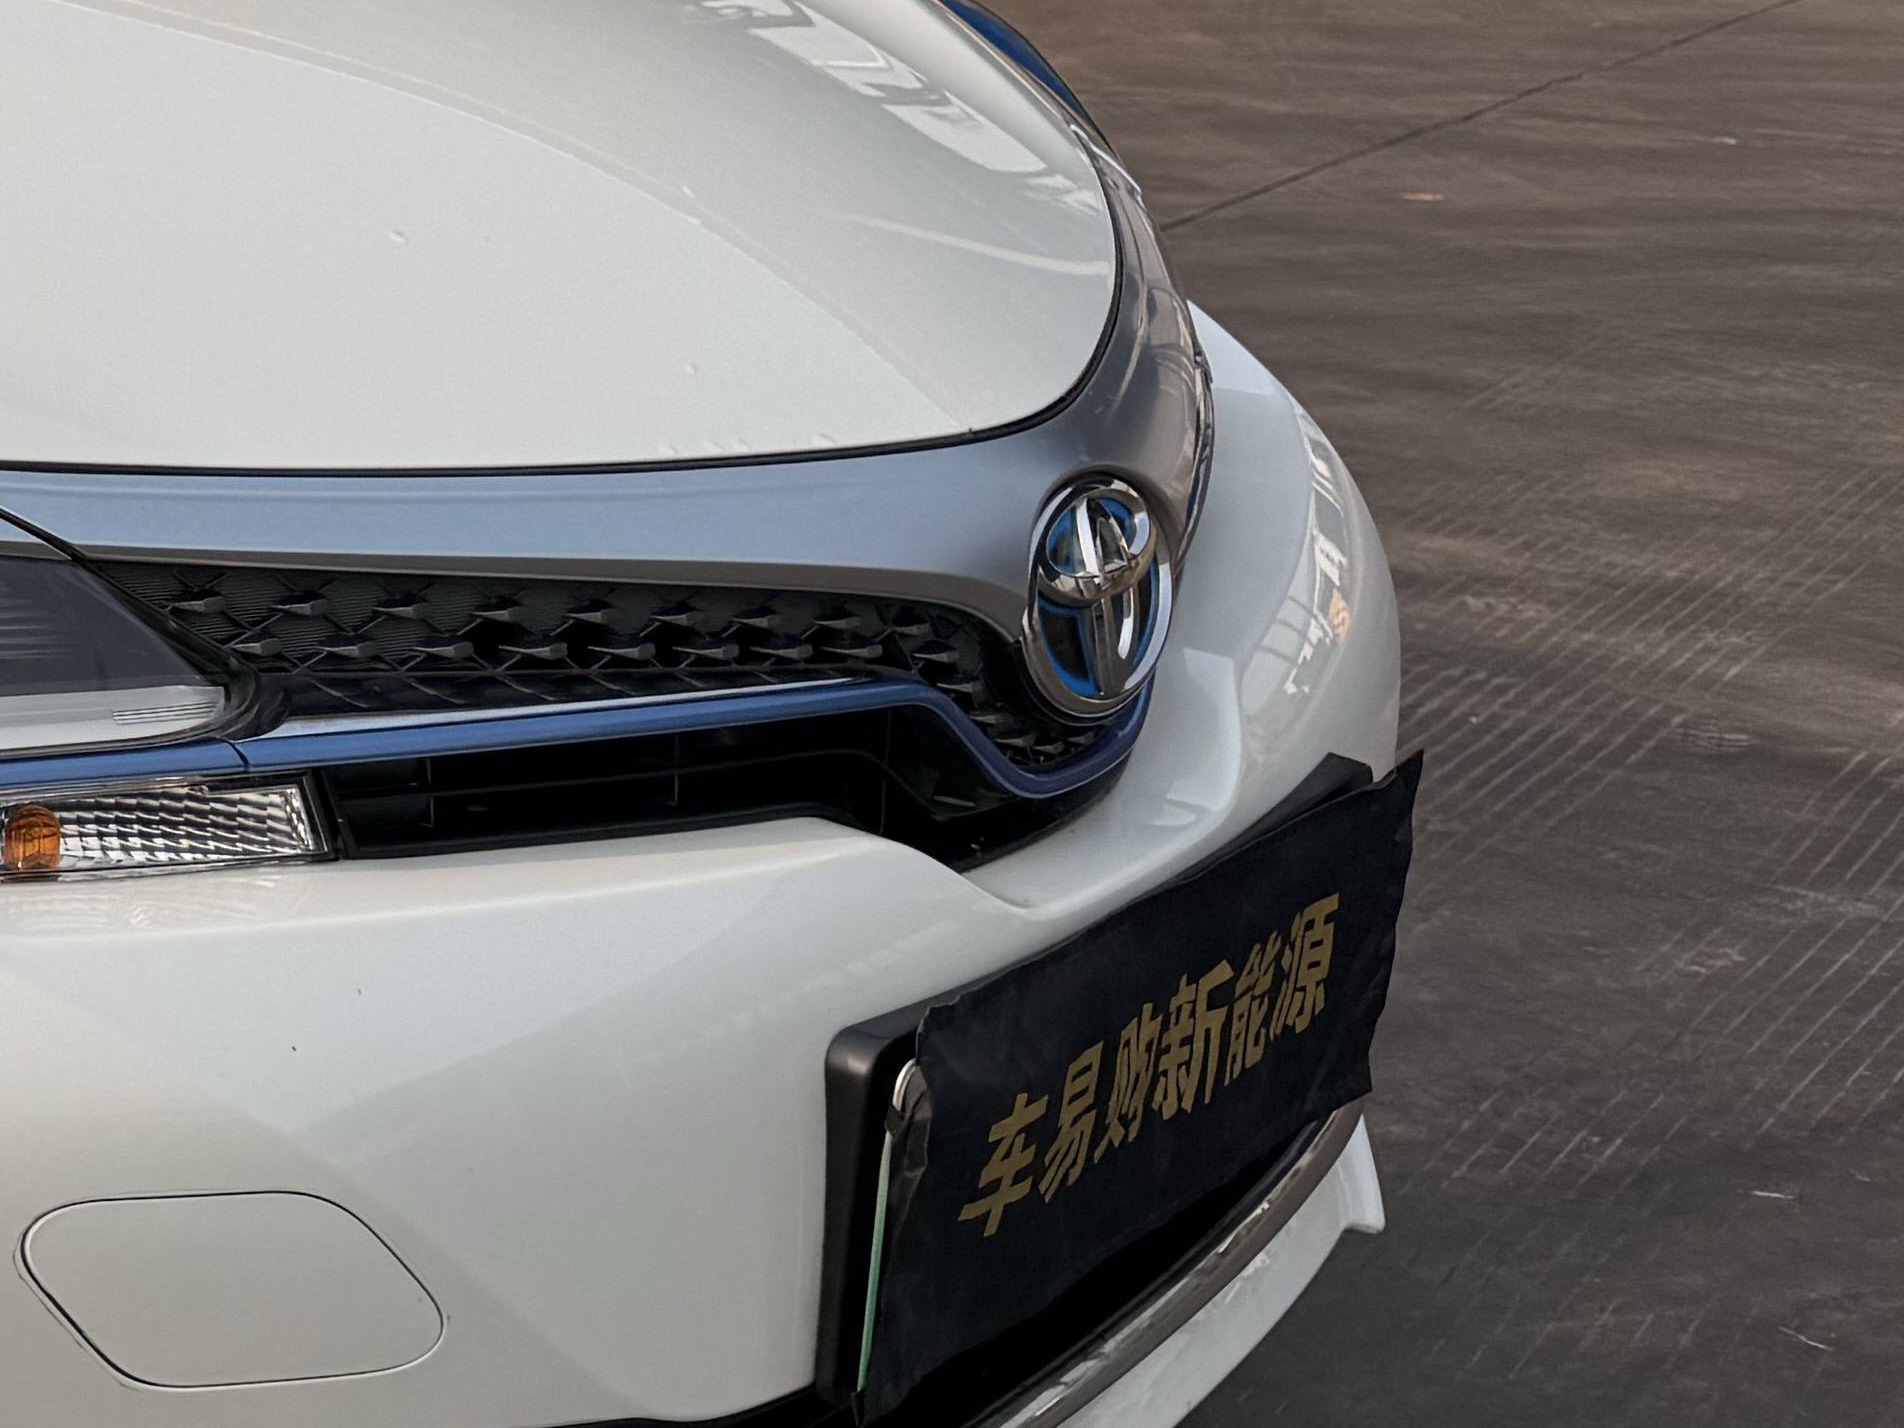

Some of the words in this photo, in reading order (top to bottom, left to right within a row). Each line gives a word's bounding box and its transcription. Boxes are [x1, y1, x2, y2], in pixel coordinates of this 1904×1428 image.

[958, 892, 1340, 1237] 车易购新能源
